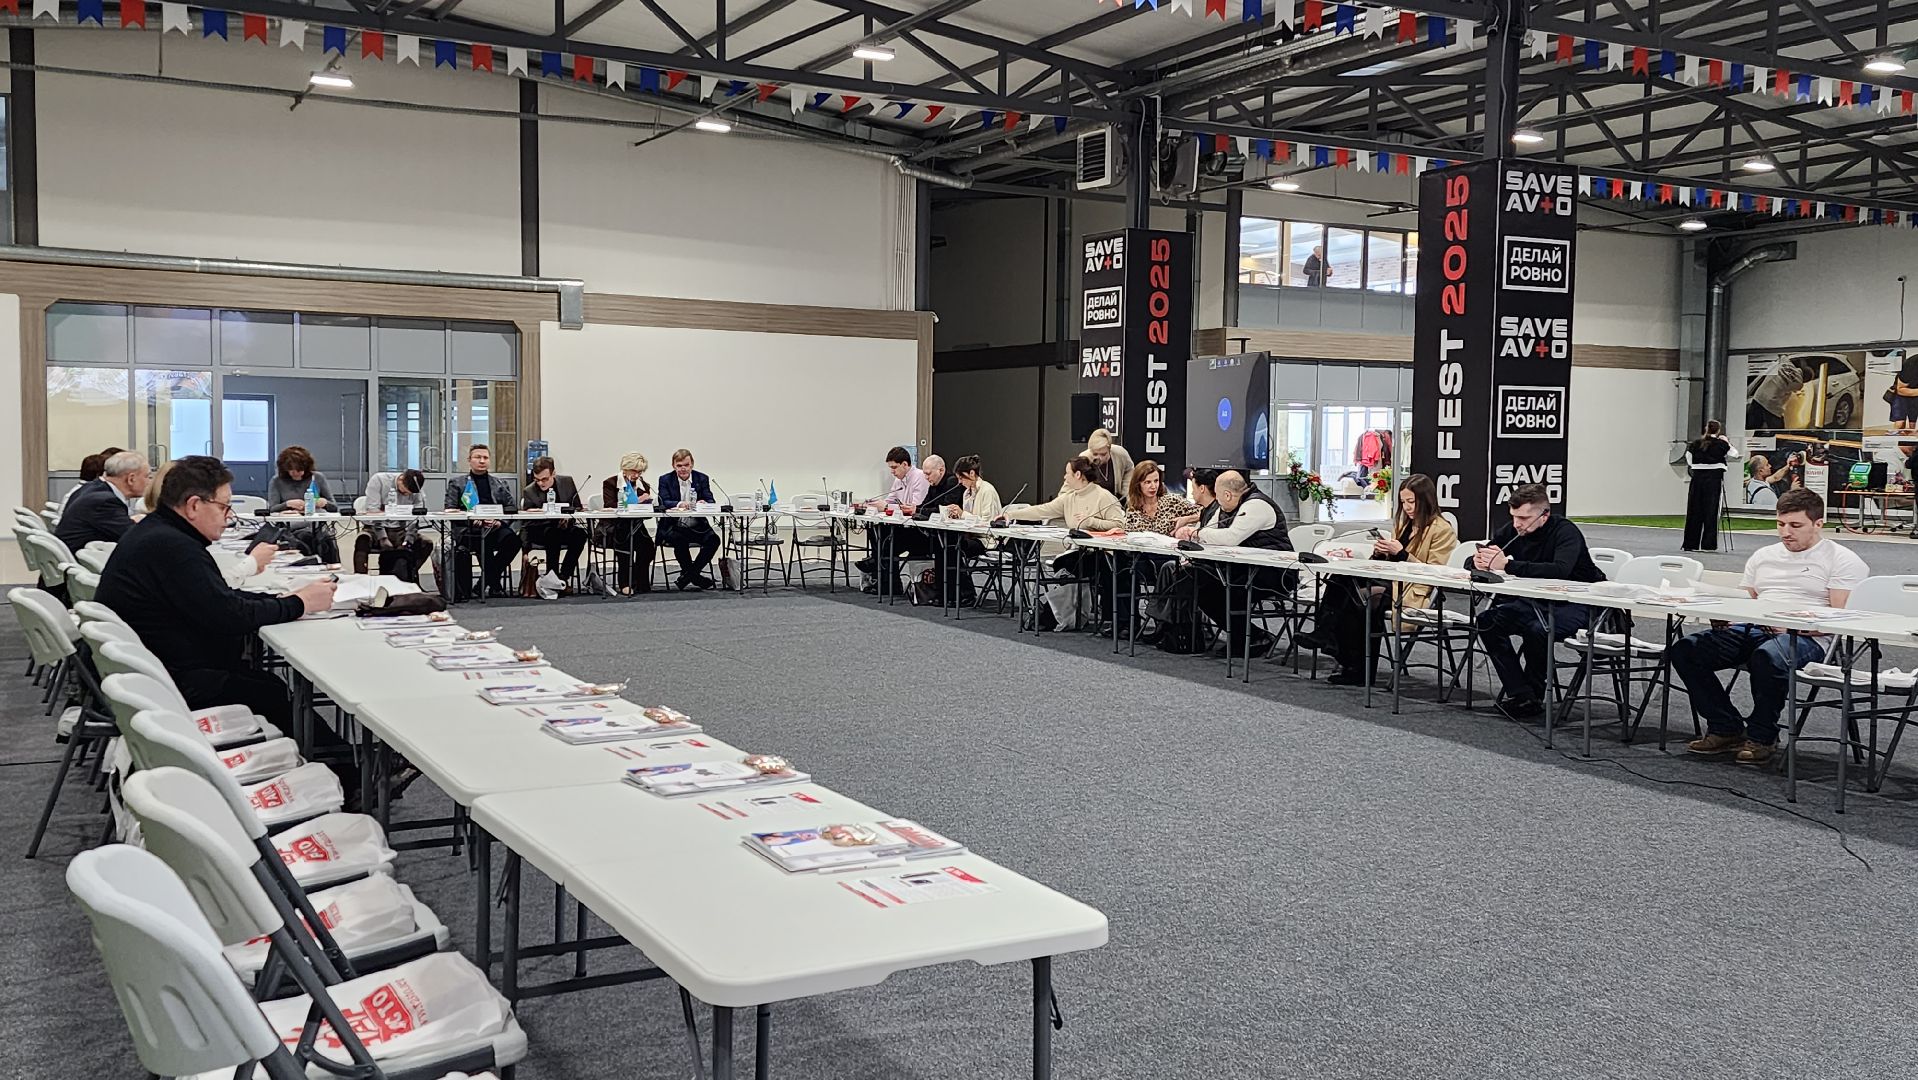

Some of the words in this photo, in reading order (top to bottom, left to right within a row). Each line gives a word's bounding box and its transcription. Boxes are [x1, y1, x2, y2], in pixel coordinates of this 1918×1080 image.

[1506, 170, 1573, 196] SAVE
[1085, 237, 1124, 258] SAVE
[1442, 175, 1470, 315] 2025
[1510, 246, 1562, 265] ДЕЛАЙ
[1510, 266, 1562, 282] РОВНО
[1087, 292, 1118, 310] ДЕЛАЙ
[1148, 238, 1171, 345] 2025
[1087, 308, 1118, 322] РОВНО
[1500, 316, 1568, 338] SAVE
[1082, 345, 1121, 363] SAVE
[1146, 353, 1168, 453] FEST
[1437, 329, 1464, 459] FEST
[1505, 393, 1557, 412] ДЕЛАЙ
[1505, 414, 1557, 429] РОВНО
[1495, 464, 1563, 484] SAVE
[1496, 485, 1562, 505] AO
